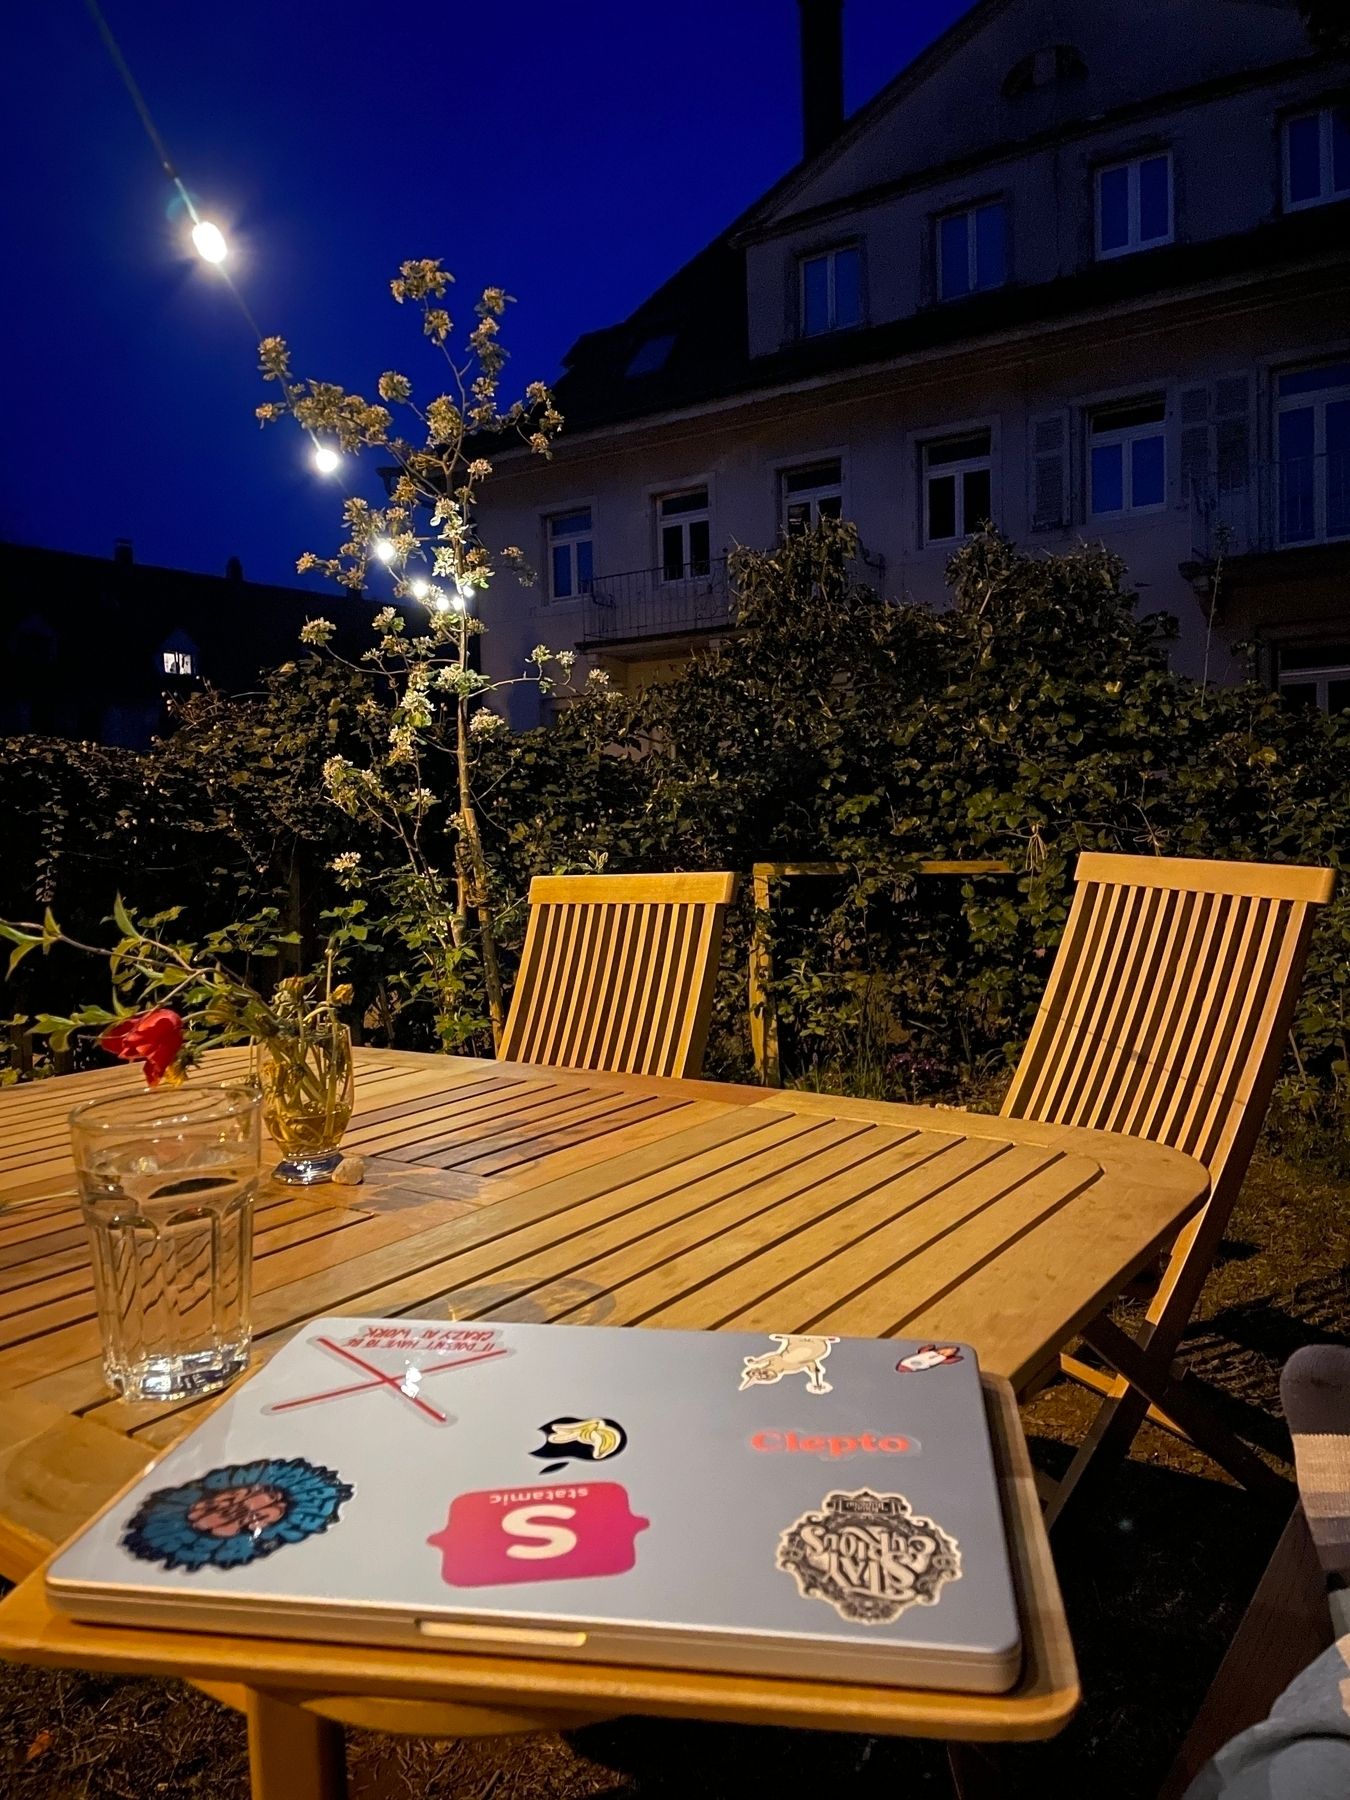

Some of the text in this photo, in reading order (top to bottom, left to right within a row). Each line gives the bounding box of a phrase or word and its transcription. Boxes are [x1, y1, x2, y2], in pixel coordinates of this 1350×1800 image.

[367, 1327, 412, 1339] WORK
[439, 1330, 494, 1341] CRAZY
[347, 1338, 365, 1347] BE
[365, 1339, 381, 1348] TO
[390, 1339, 420, 1349] HAVE
[427, 1341, 474, 1351] DOESN'T
[751, 1430, 909, 1457] Clepto
[489, 1487, 589, 1506] statamic
[501, 1504, 577, 1560] S
[822, 1550, 916, 1601] STAY
